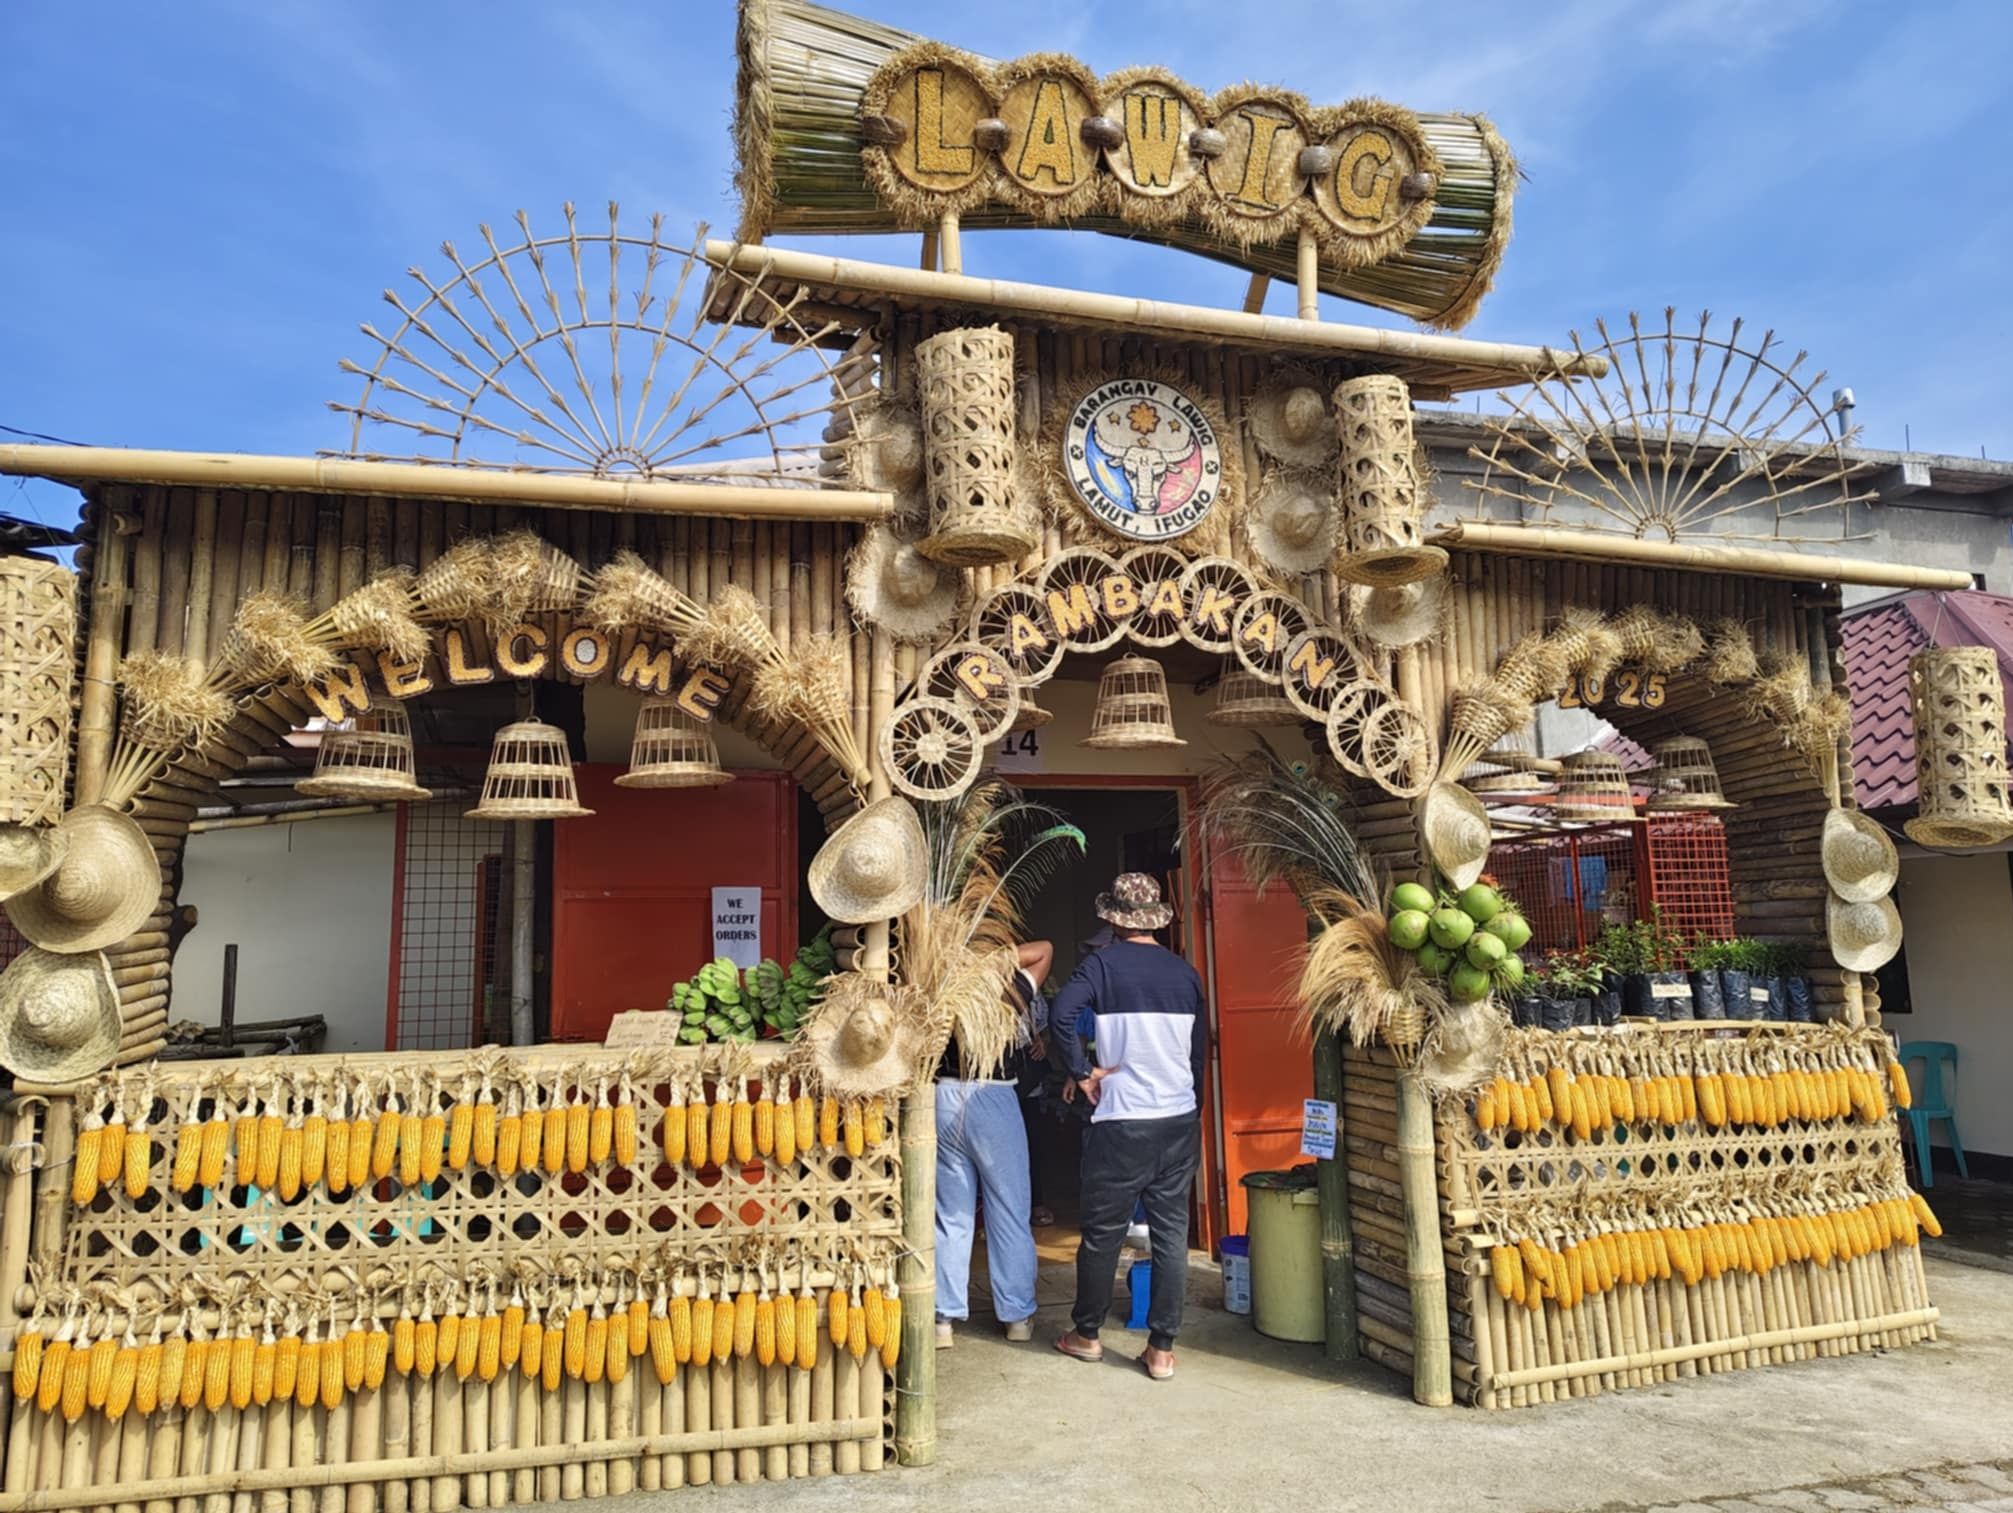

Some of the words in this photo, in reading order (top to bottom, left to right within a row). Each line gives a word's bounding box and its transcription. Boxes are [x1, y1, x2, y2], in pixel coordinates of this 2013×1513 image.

[914, 67, 1394, 221] LAWIG
[1074, 381, 1157, 429] BARANGAY
[1171, 395, 1213, 446] LAWIG
[1155, 489, 1210, 532] IFUGAO
[953, 573, 1333, 700] RAMBAKAN
[304, 622, 731, 724] WELCOME
[1558, 668, 1667, 709] 2025
[717, 914, 755, 925] ACCEPT
[727, 898, 743, 909] WE
[716, 930, 757, 941] ORDERS
